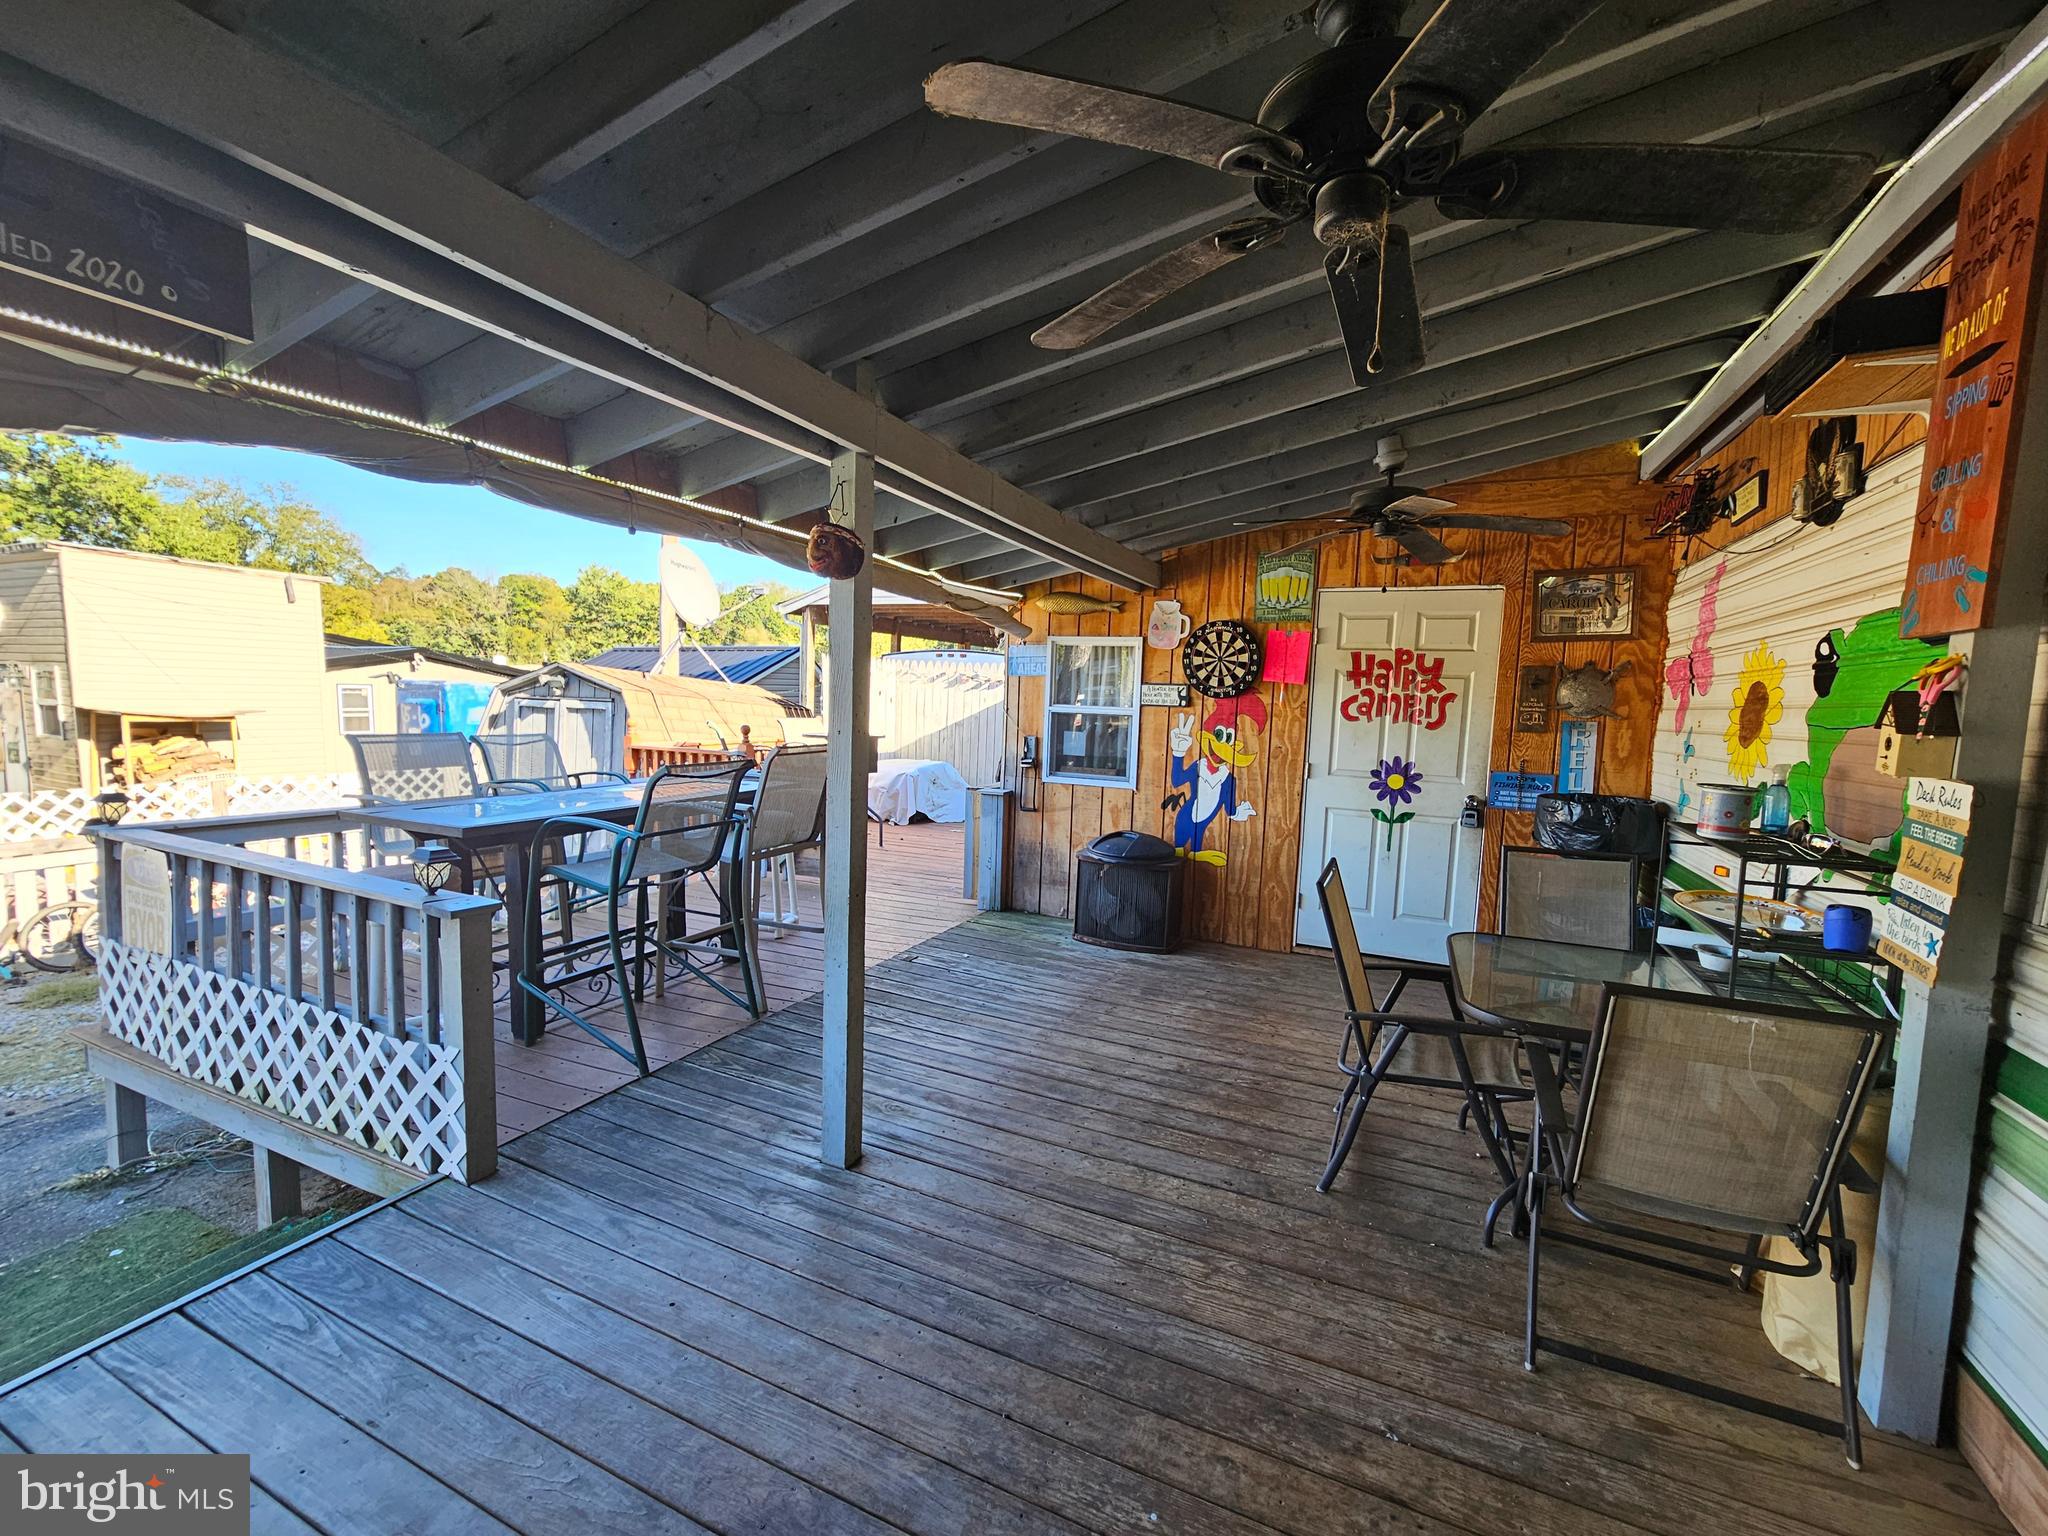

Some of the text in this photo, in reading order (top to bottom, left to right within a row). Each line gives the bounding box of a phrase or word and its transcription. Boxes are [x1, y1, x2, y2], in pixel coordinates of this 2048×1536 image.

[1968, 153, 2032, 229] WELCOME
[1970, 227, 1987, 251] TO
[65, 248, 144, 295] 2020
[1944, 326, 1957, 359] WE
[1956, 318, 1969, 351] DO
[1993, 287, 2009, 325] OF
[1945, 375, 1989, 419] SIPPING
[1930, 453, 1983, 492] GRILLING
[1940, 508, 1955, 533] &
[1917, 555, 1966, 585] CHILLING
[1568, 728, 1592, 792] REL
[1916, 781, 1962, 810] Deck Rules
[1910, 824, 1958, 850] FEEL THE BREEZE
[1899, 878, 1912, 891] SIP
[1920, 887, 1948, 910] DRINK
[1887, 923, 1921, 954] the birds
